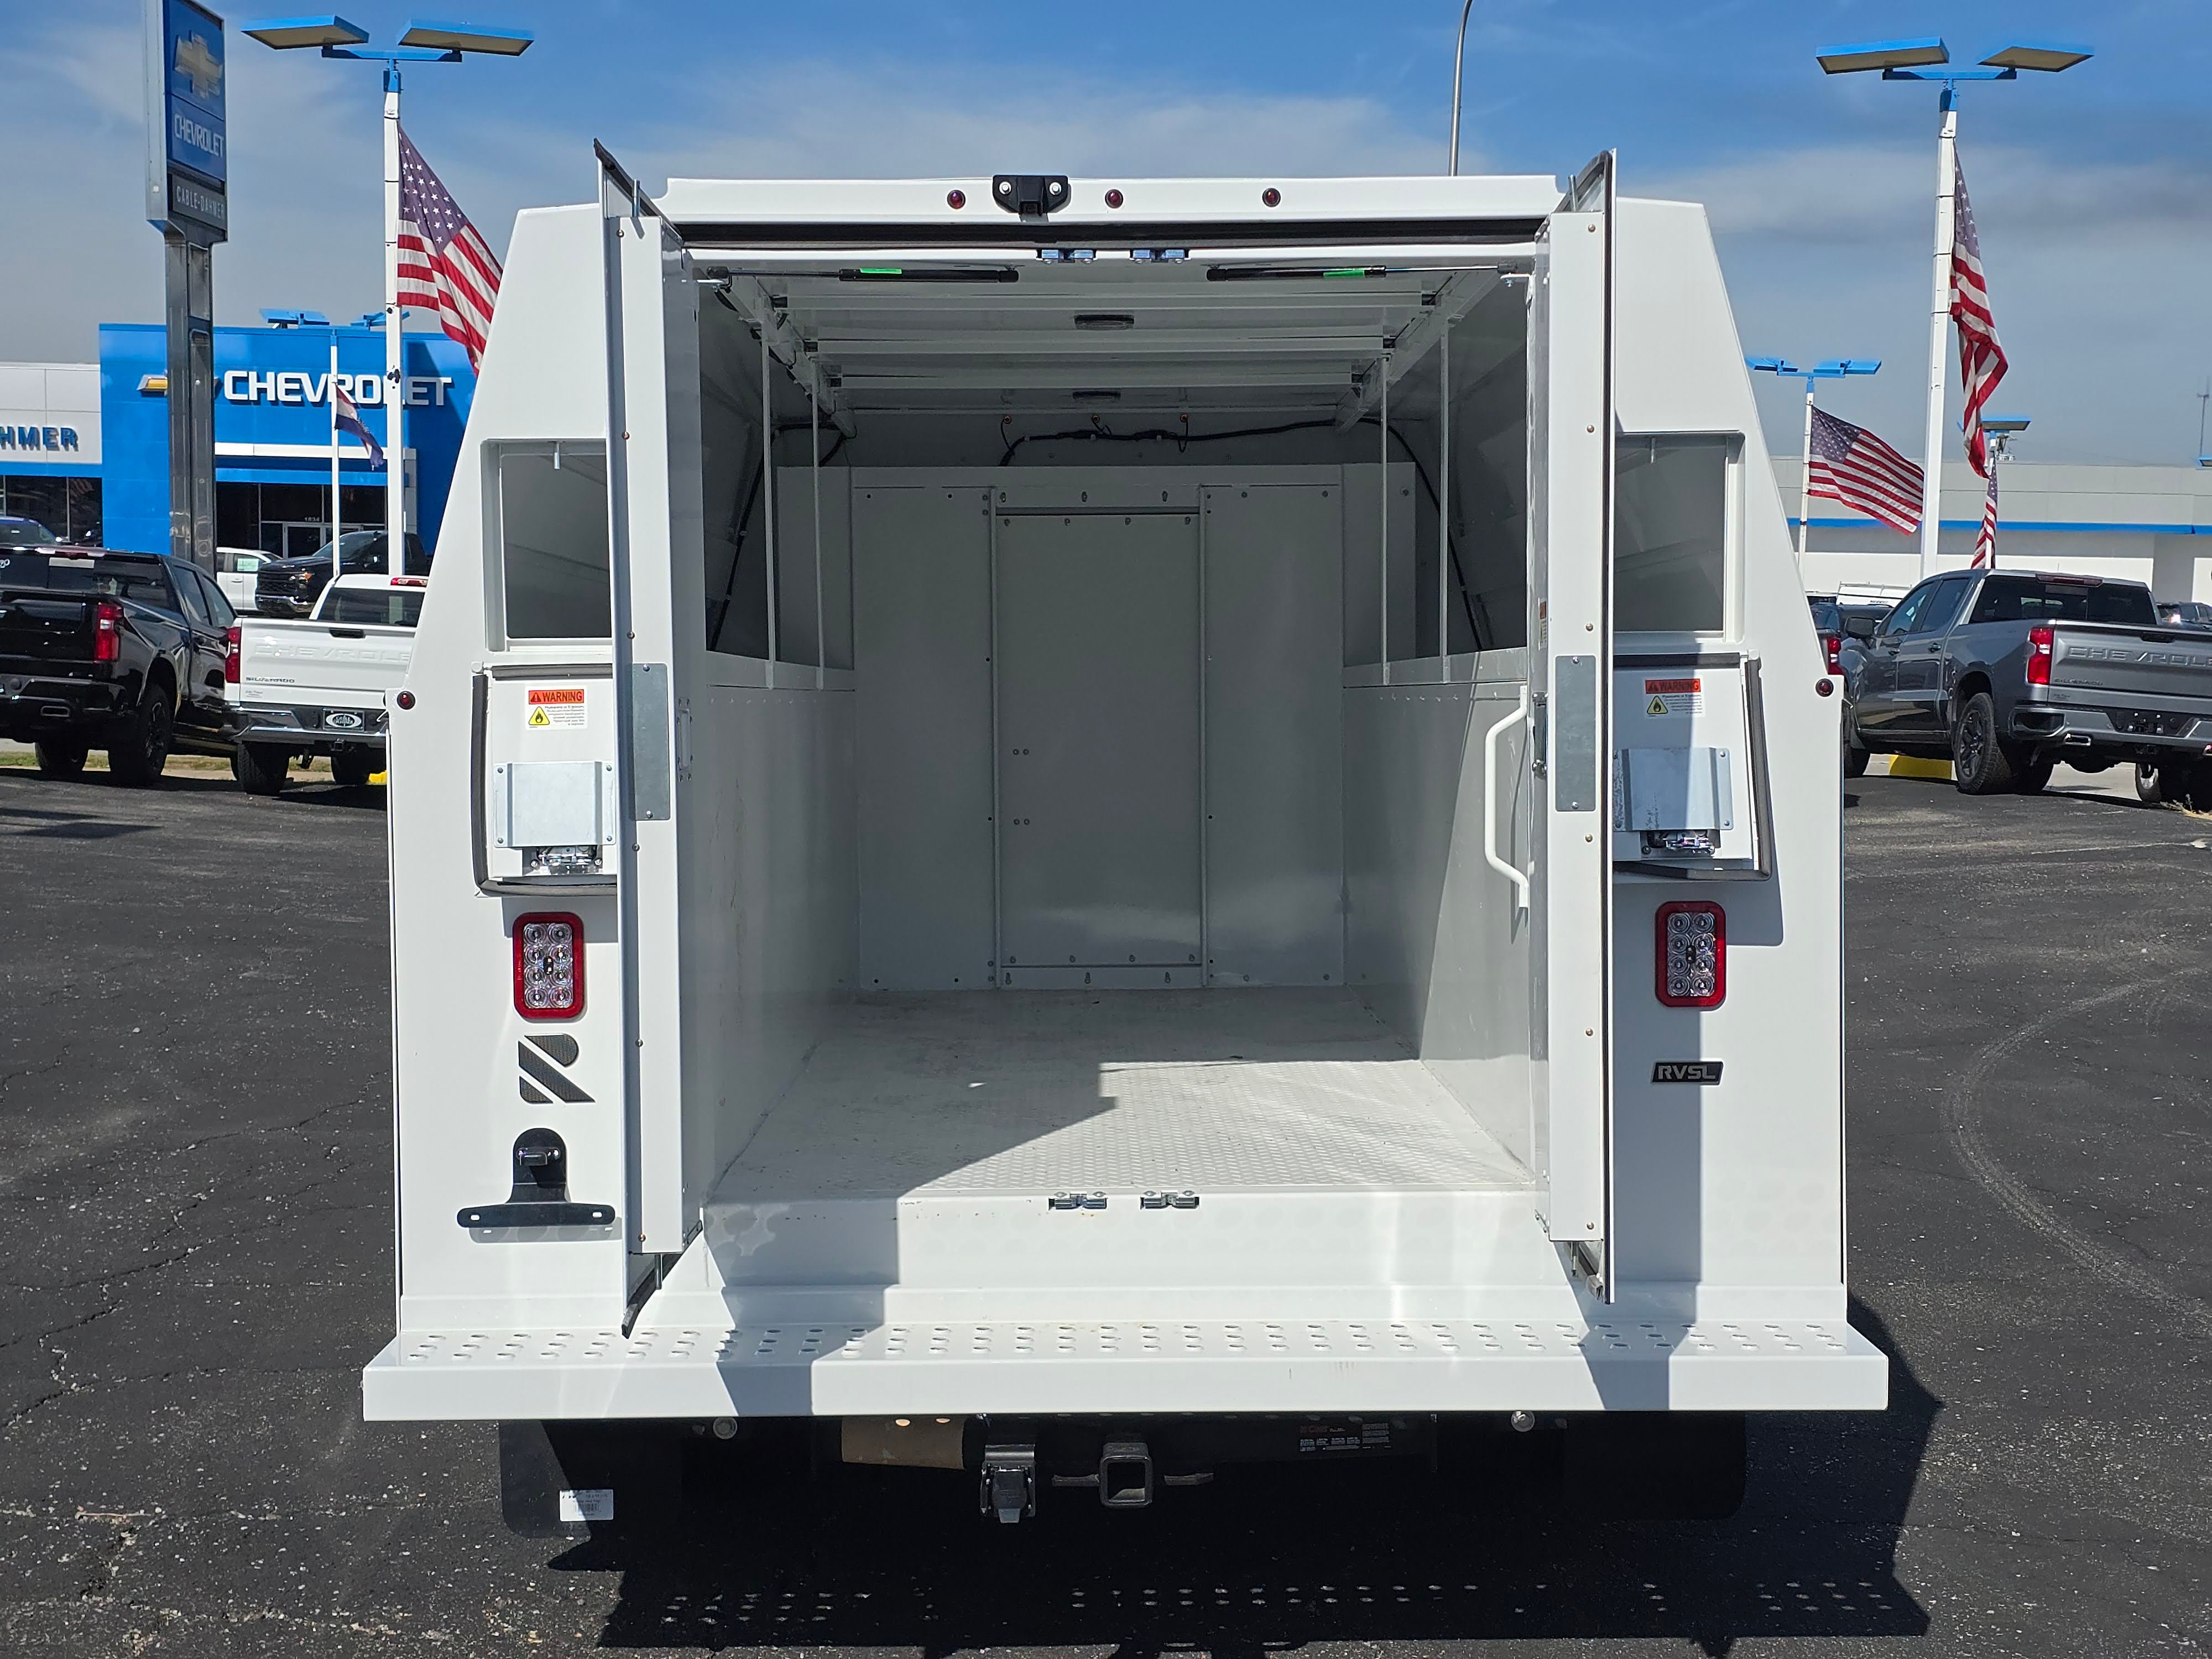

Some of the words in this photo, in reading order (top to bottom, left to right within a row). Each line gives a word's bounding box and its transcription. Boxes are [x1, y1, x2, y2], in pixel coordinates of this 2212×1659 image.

[174, 114, 224, 158] CHEVROLET
[2068, 646, 2212, 667] CHEVROL
[1660, 681, 1699, 691] WARNING
[542, 691, 582, 702] WARNING
[1658, 1065, 1715, 1079] RVSL
